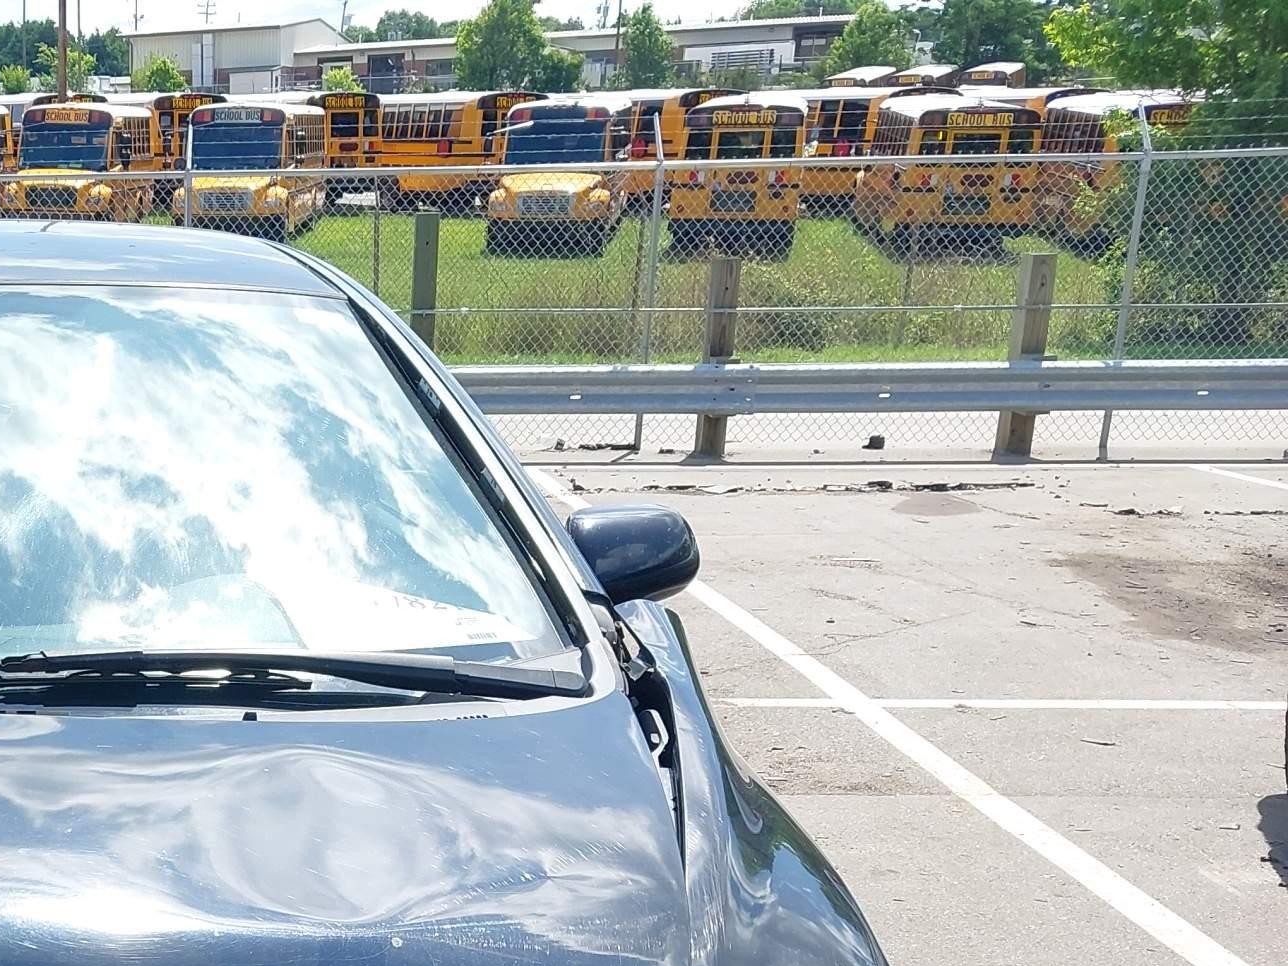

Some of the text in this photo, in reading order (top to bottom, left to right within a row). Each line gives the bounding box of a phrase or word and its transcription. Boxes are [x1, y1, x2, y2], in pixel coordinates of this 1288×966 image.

[45, 111, 88, 122] SCHOOL BUS
[215, 110, 261, 121] SCHOOL BUS
[714, 112, 752, 124] SCHOOL
[948, 113, 1013, 125] SCHOOL BUS
